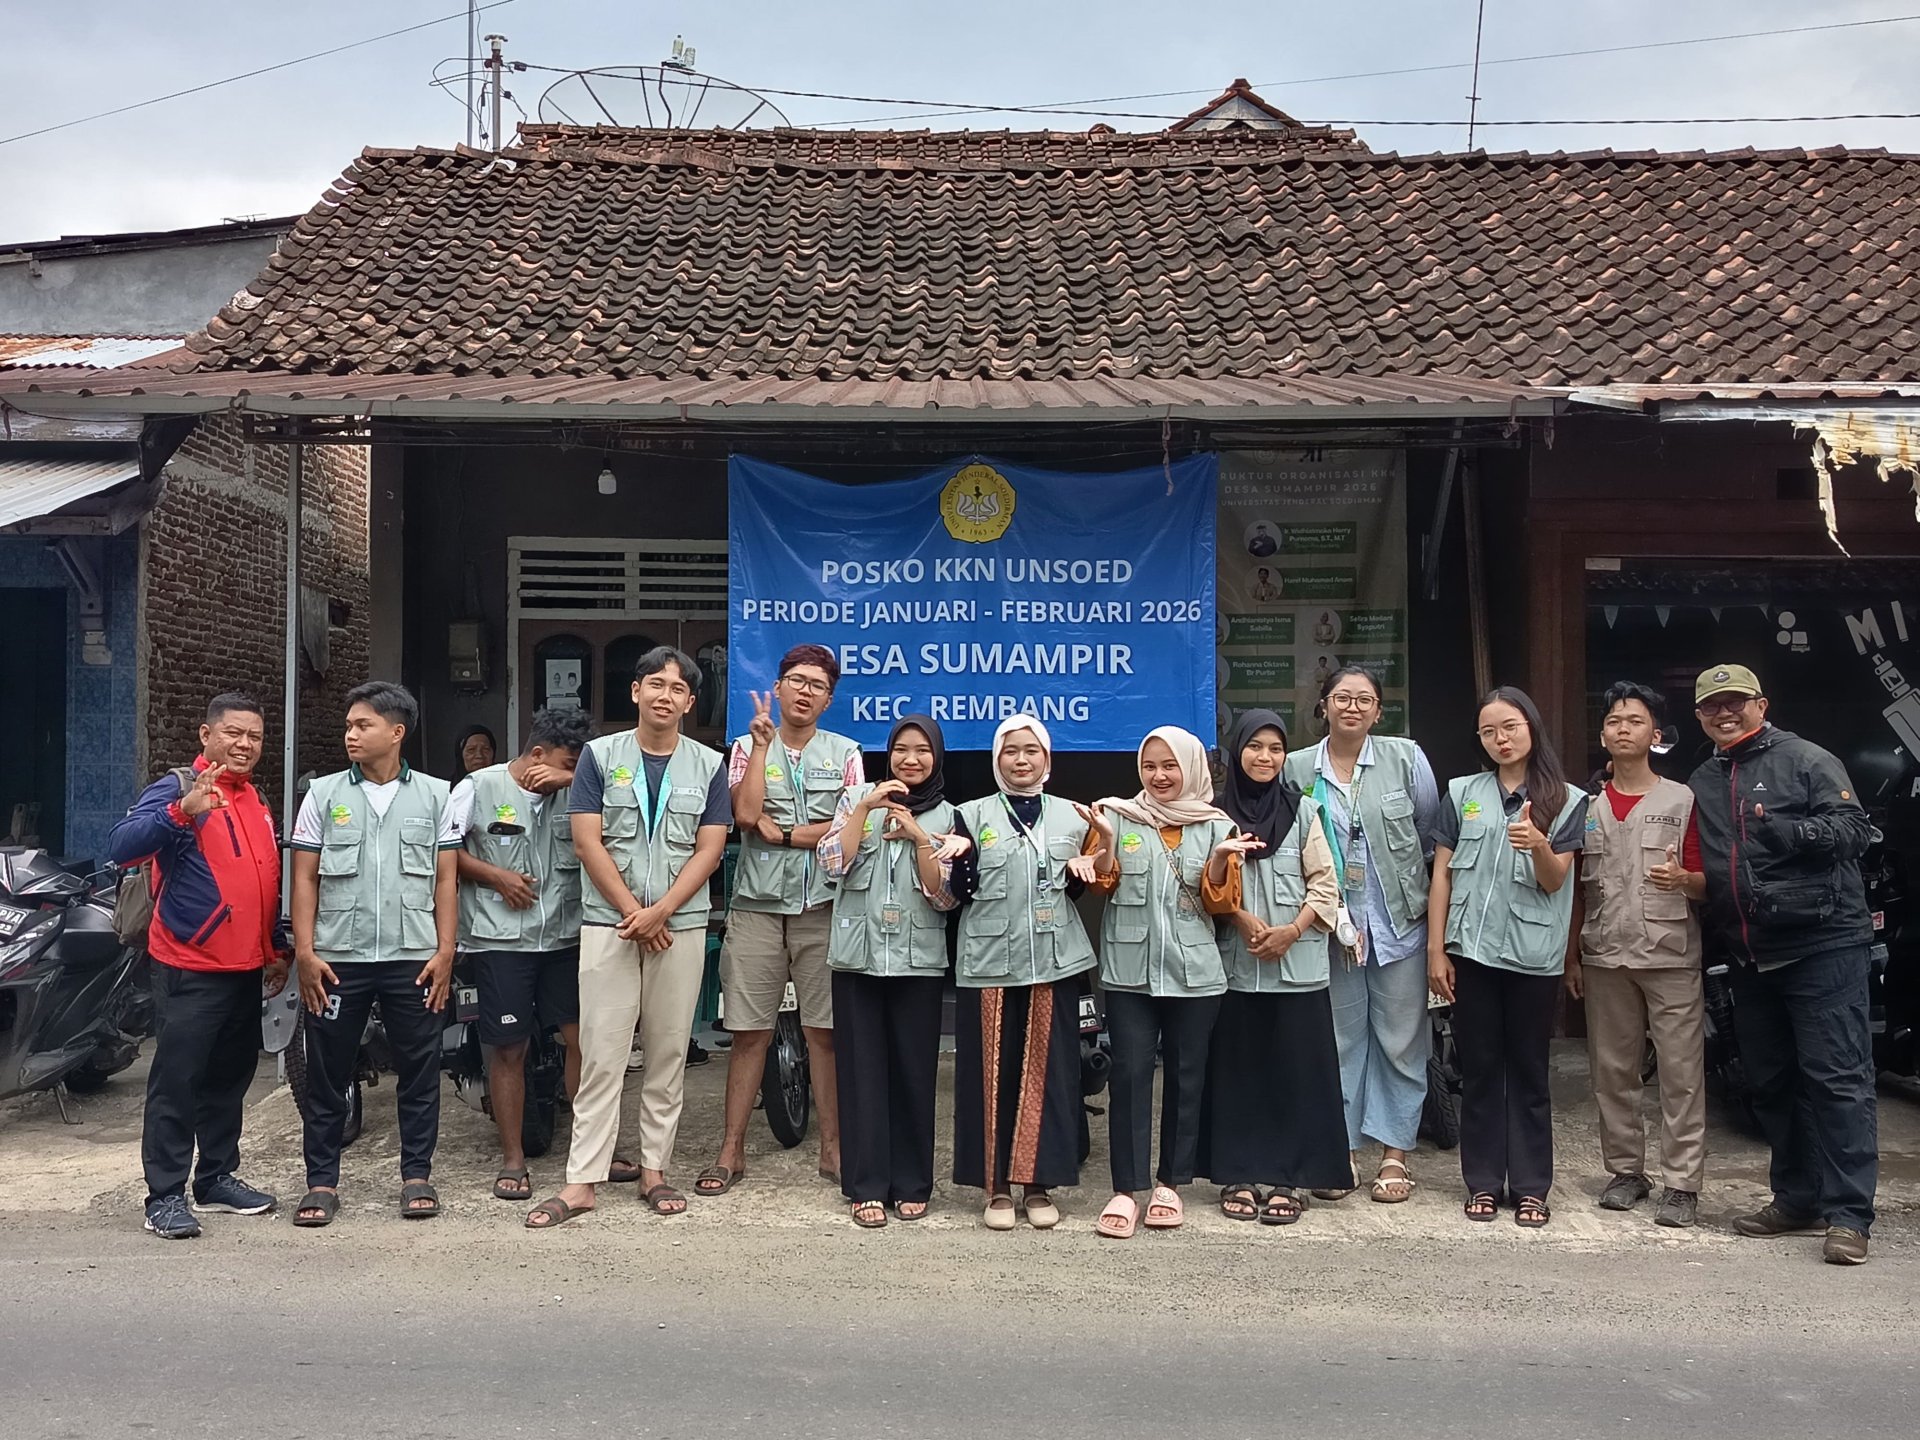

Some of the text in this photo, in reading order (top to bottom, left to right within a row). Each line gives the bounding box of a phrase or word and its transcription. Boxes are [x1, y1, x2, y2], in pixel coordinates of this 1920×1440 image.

[1279, 470, 1365, 481] ORGANISASI
[1224, 482, 1377, 494] DESA SUMAMPIR 2026
[1221, 496, 1383, 506] UNIVERSITAS JENDERAL SOEDIRMAN
[821, 557, 1133, 585] POSKO KKN UNSOED
[743, 599, 855, 624] PERIODE
[860, 600, 977, 629] JANUARI
[1001, 600, 1131, 623] FEBRUARI
[1141, 599, 1201, 623] 2026
[818, 643, 1134, 675] ESA SUMAMPIR
[930, 695, 1090, 722] REMBANG
[324, 994, 342, 1020] 9
[464, 991, 472, 1005] R
[1086, 1002, 1096, 1015] A
